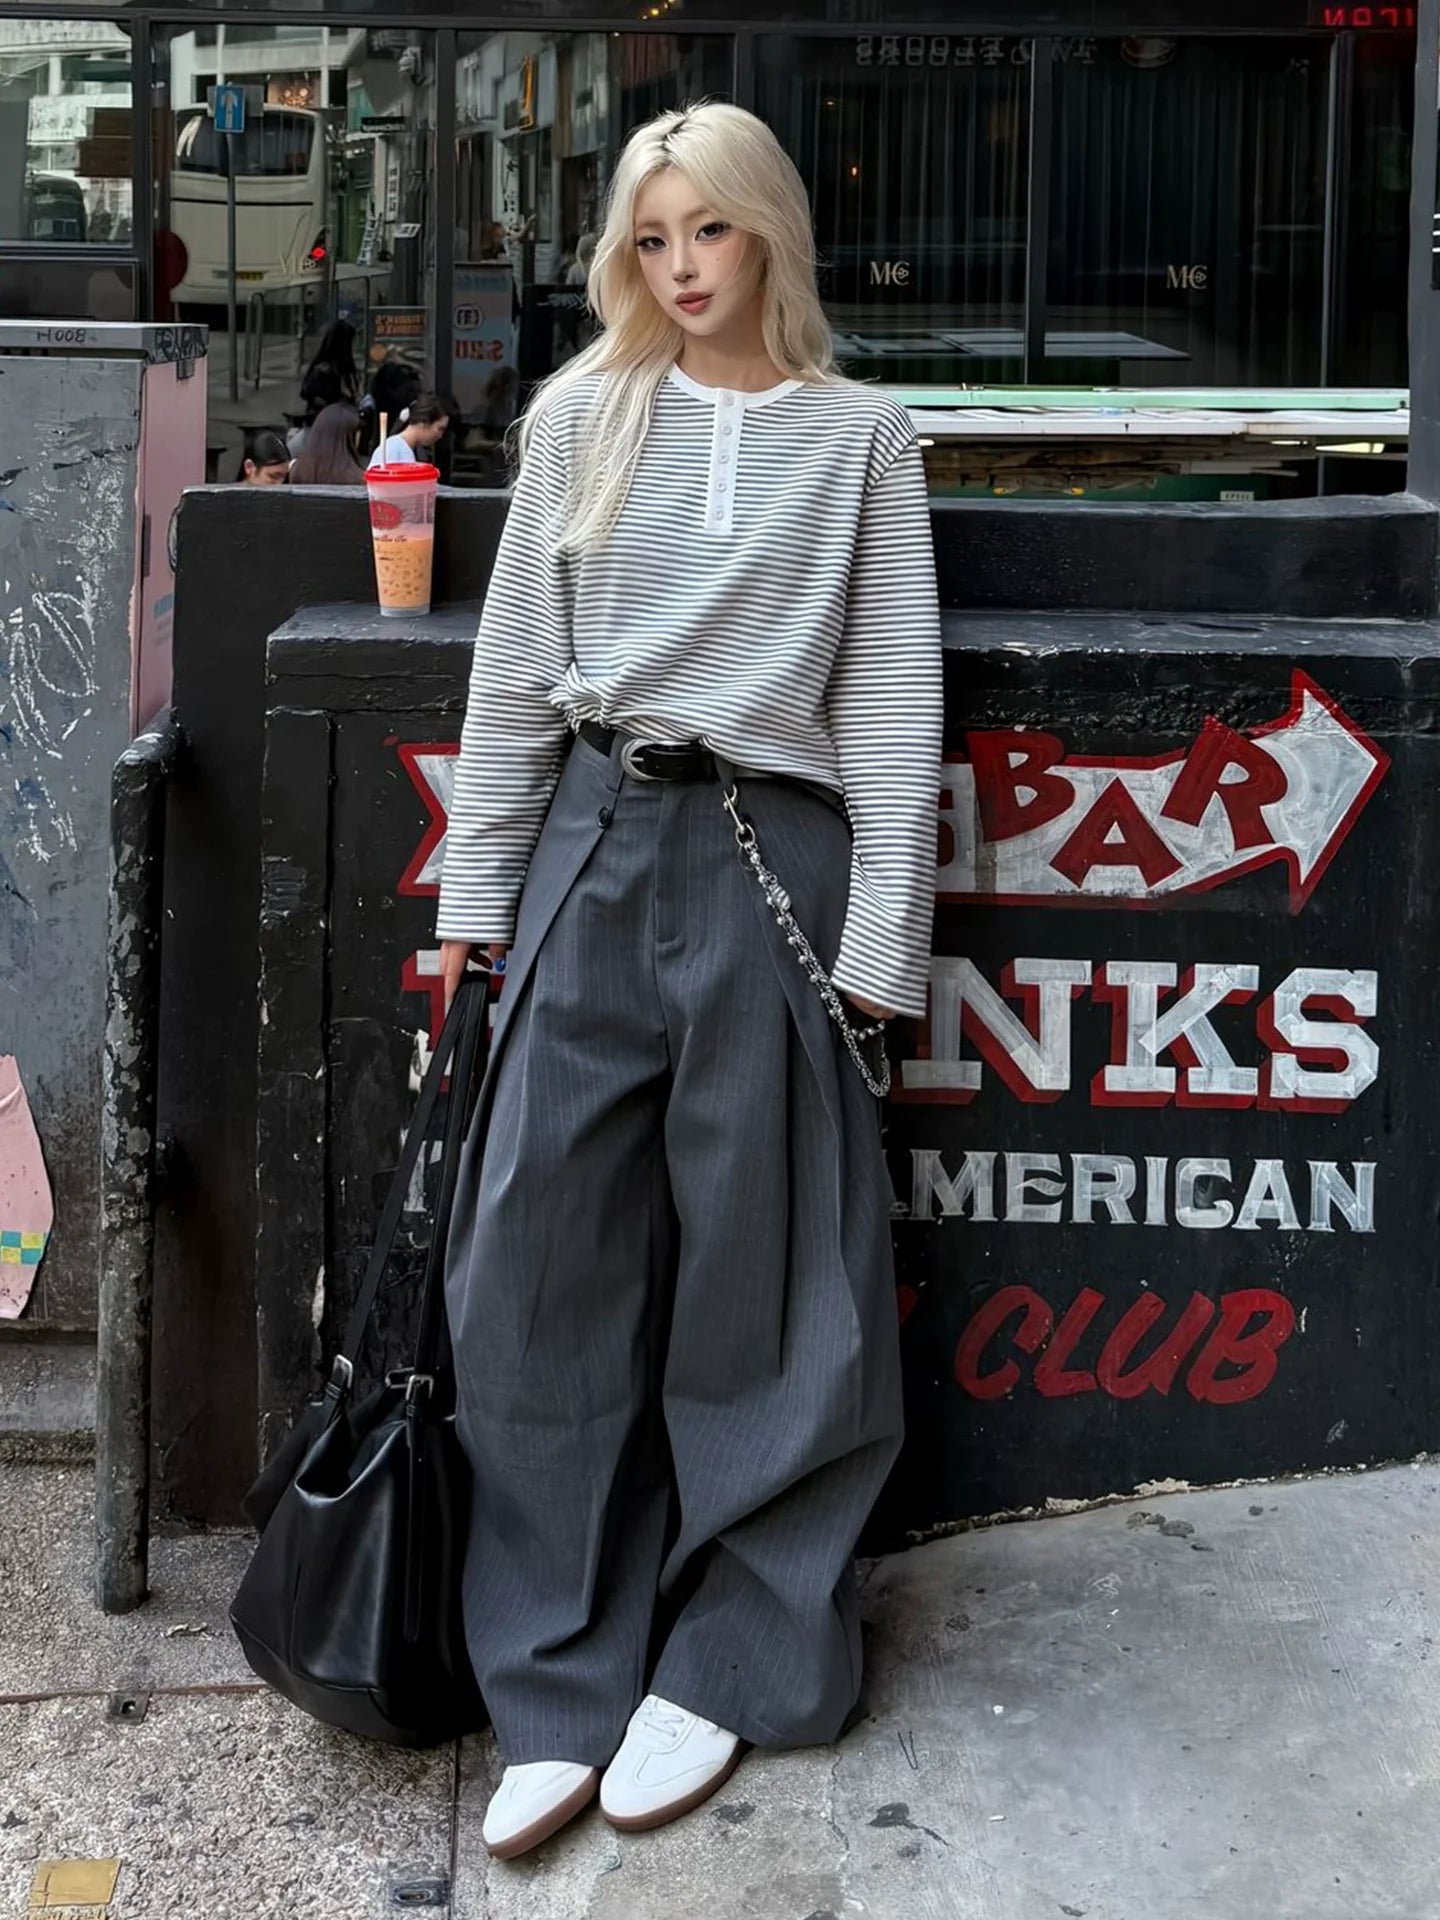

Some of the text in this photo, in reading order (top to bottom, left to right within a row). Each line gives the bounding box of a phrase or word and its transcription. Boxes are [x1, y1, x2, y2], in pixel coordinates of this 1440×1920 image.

[966, 715, 1290, 890] BAR
[889, 1149, 1377, 1233] MERICAN
[954, 1285, 1295, 1405] CLUB
